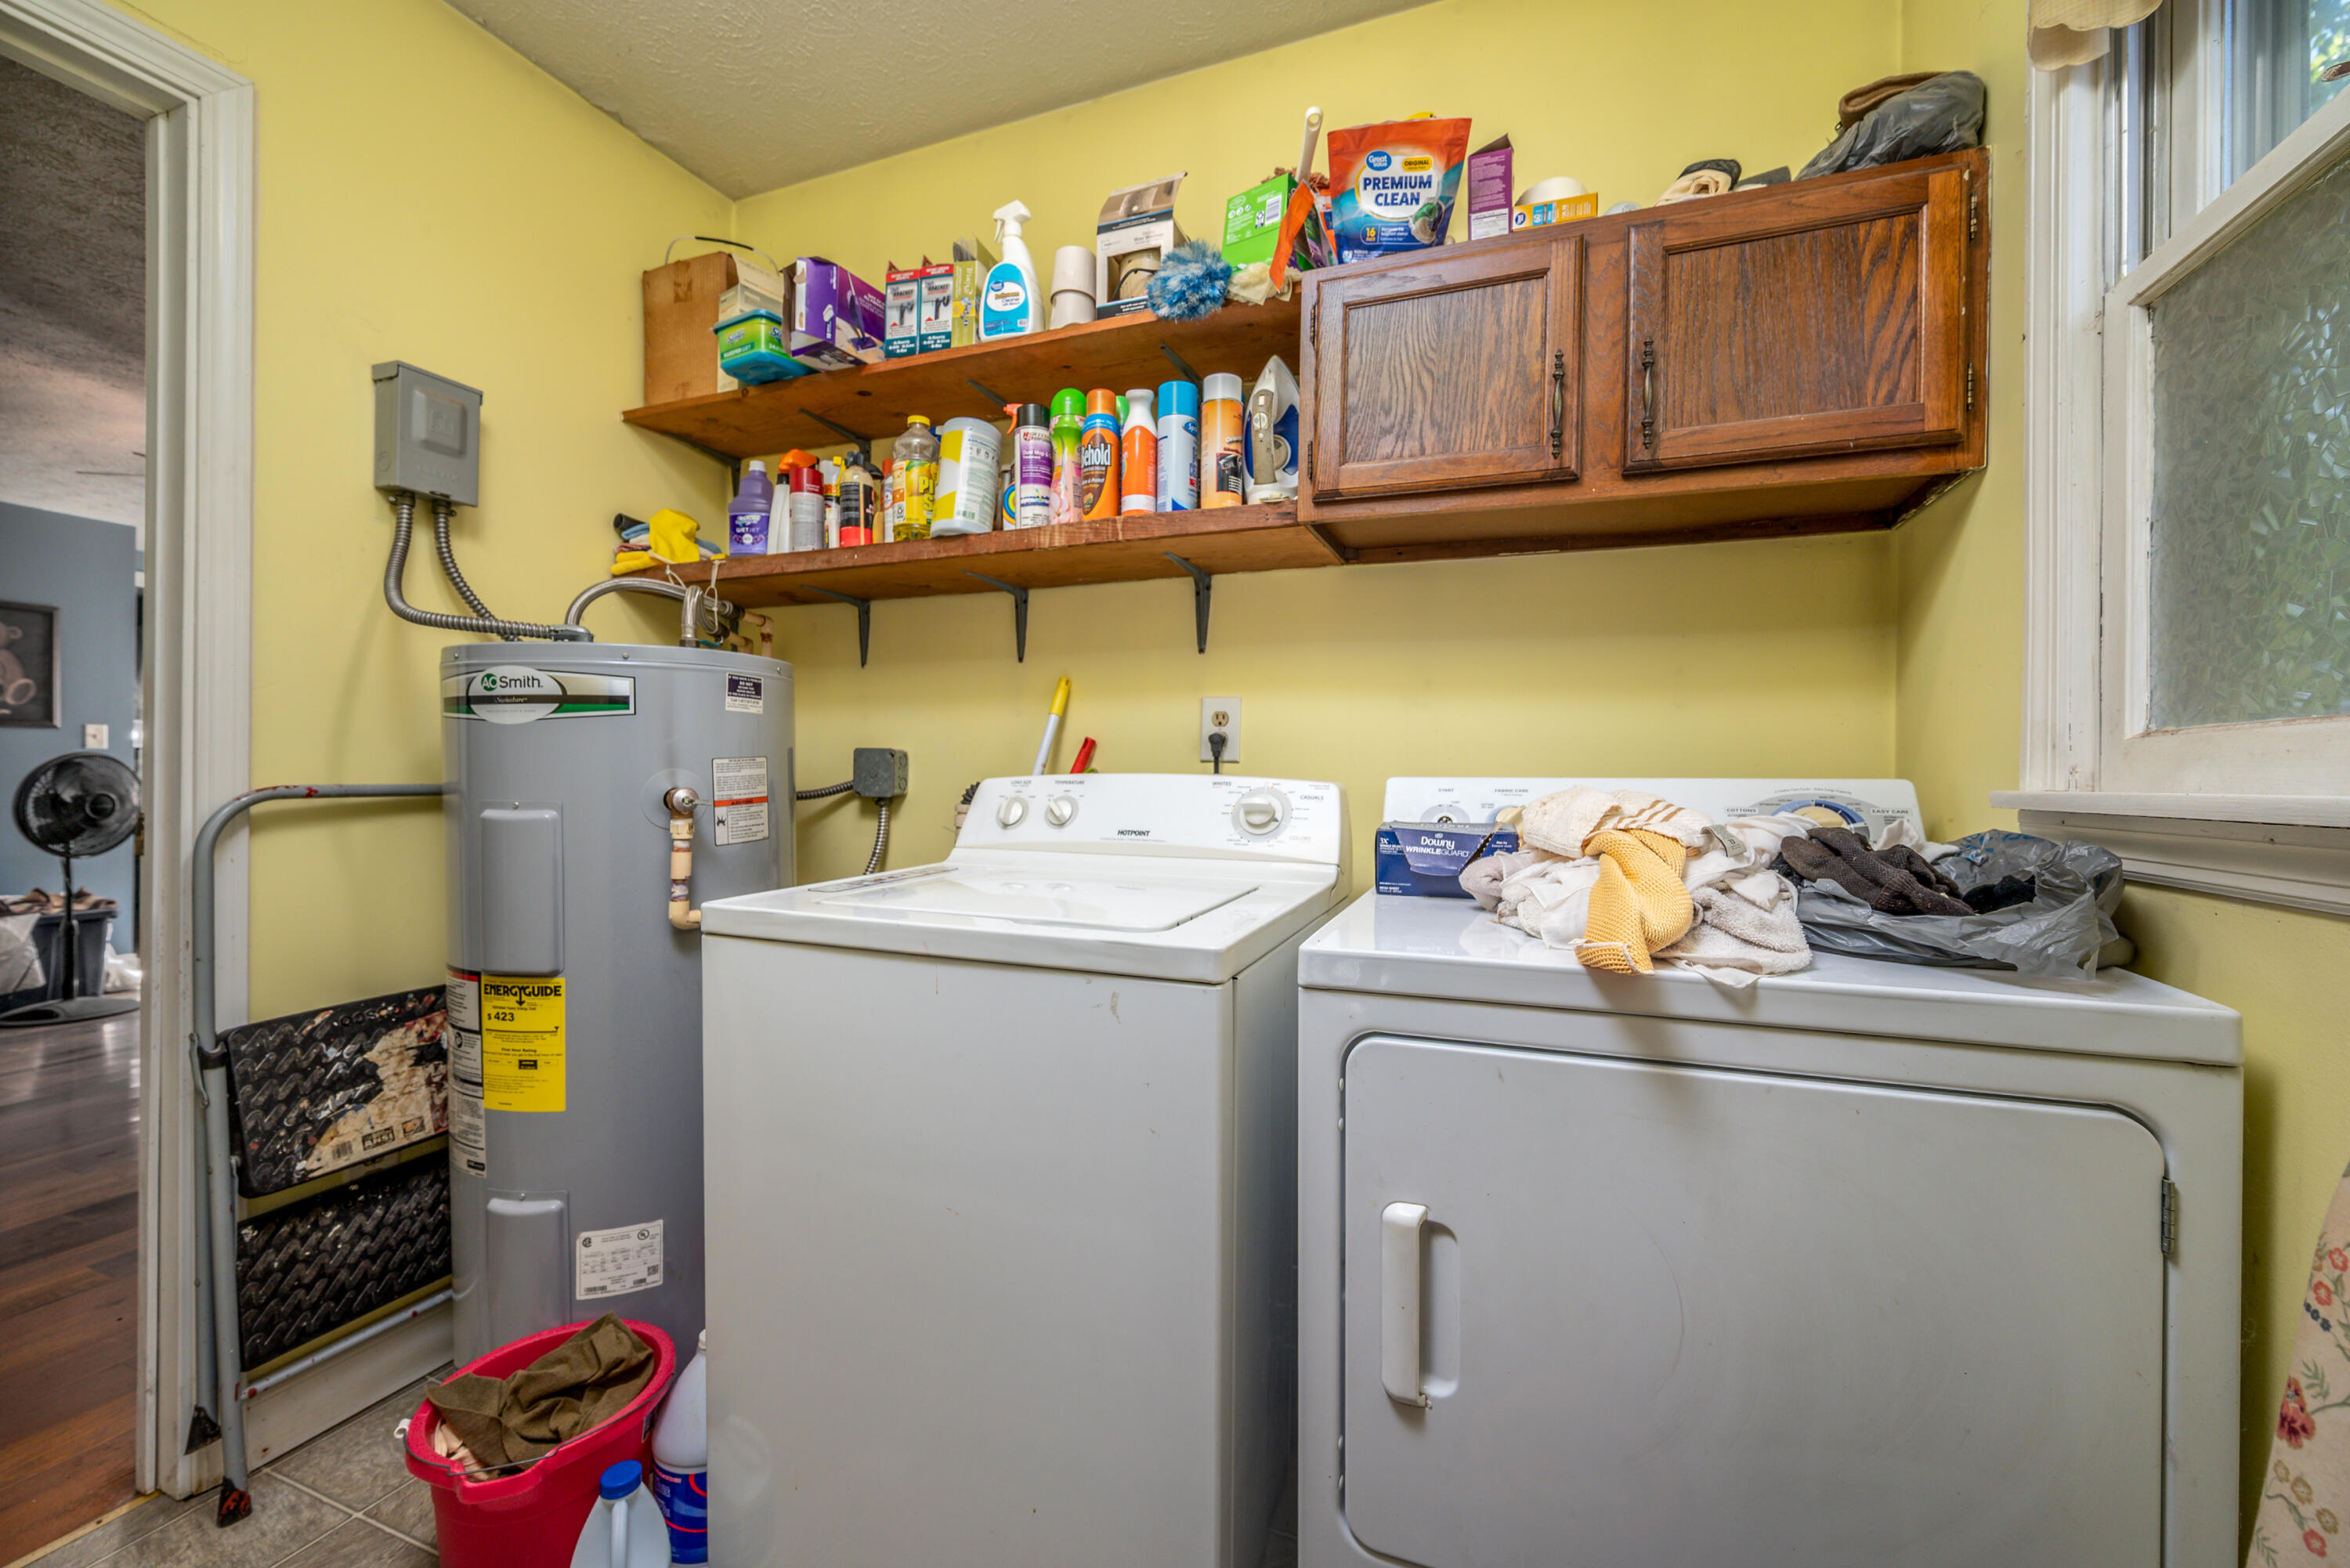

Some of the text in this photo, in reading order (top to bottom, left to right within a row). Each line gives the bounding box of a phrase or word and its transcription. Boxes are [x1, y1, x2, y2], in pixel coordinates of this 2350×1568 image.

[1363, 175, 1433, 190] PREMIUM
[1375, 192, 1420, 206] CLEAN
[1366, 227, 1376, 237] 16
[499, 675, 540, 688] Smith
[1421, 836, 1455, 850] Downy
[1406, 845, 1469, 858] WRINKLEGUARD
[494, 1011, 515, 1022] 423
